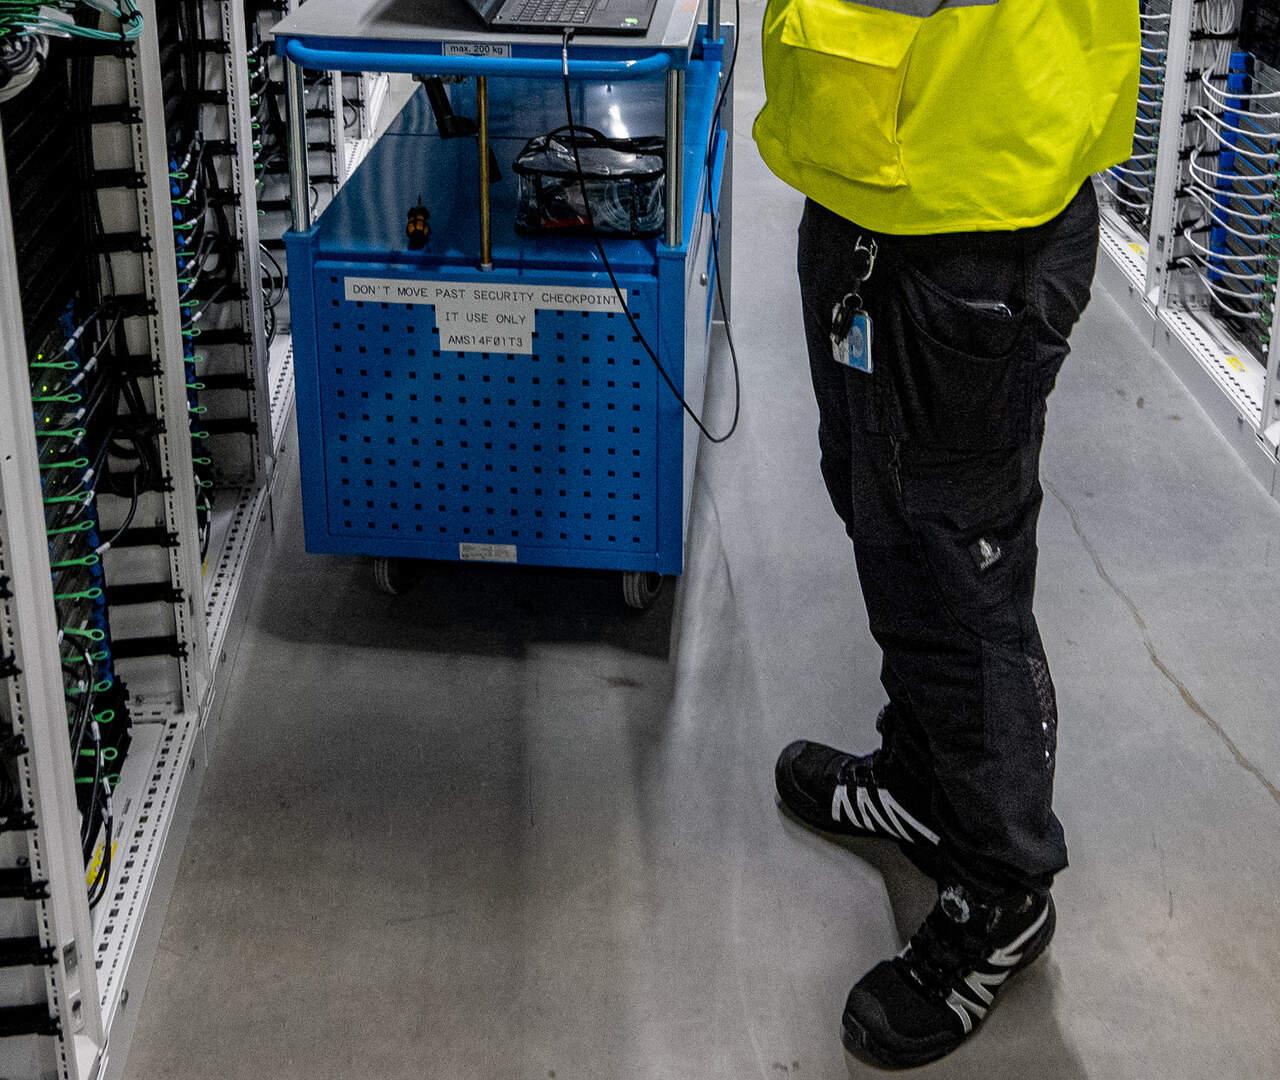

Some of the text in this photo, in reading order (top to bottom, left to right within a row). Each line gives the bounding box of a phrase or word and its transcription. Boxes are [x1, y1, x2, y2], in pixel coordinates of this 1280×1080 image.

[450, 45, 503, 55] max. 200 kg
[352, 284, 618, 305] DON'T MOVE PAST SECURITY CHECKPOINT
[445, 311, 526, 325] IT USE ONLY
